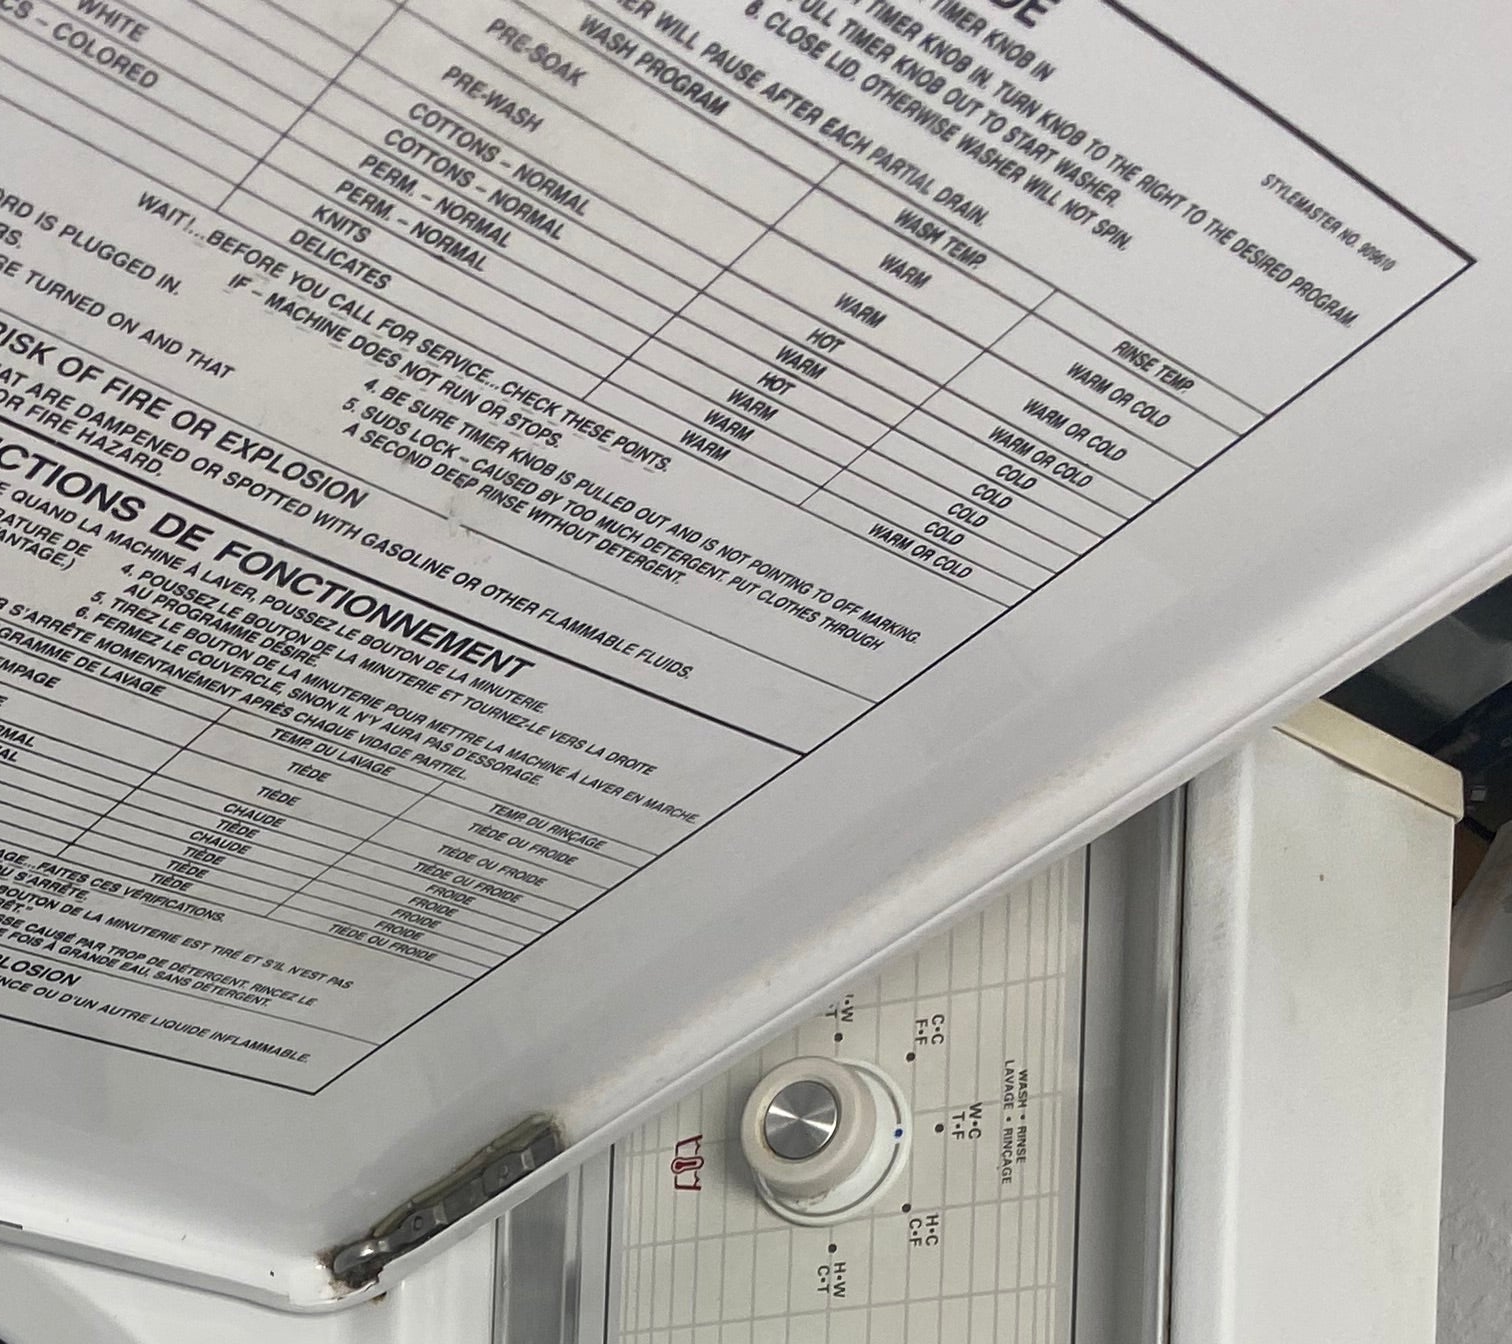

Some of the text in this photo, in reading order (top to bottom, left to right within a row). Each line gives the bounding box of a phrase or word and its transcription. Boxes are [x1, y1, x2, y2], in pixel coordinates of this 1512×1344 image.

[485, 18, 587, 87] PRE-SOAK
[579, 17, 729, 116] WASH PROGRAM
[441, 65, 543, 133] PRE-WASH
[311, 204, 372, 243] KNITS
[893, 209, 947, 244] WASH
[1260, 173, 1342, 234] STYLEMASTER
[1336, 228, 1360, 246] NO.
[288, 228, 392, 290] DELICATES
[878, 253, 932, 289] WARM
[1111, 340, 1159, 372] RINSE
[1066, 362, 1171, 428] WARM OR COLD
[56, 356, 105, 383] OF
[100, 376, 172, 420] FIRE
[170, 410, 217, 441] OR
[214, 430, 369, 509] EXPLOSION
[24, 382, 76, 411] ARE
[73, 402, 190, 463] DAMPENED
[190, 456, 224, 479] OR
[221, 471, 312, 518] SPOTTED
[311, 509, 363, 540] WITH
[360, 532, 455, 579] GASOLINE
[451, 571, 482, 591] OR
[480, 584, 540, 615] OTHER
[536, 607, 640, 655] FLAMMABLE
[633, 648, 694, 679] FLUIDS.
[149, 512, 215, 552] DE
[212, 540, 536, 678] FONCTIONNEMENT
[72, 656, 102, 673] DE
[99, 665, 167, 697] LAVAGE
[311, 742, 339, 757] DU
[336, 750, 396, 777] LAVAGE
[222, 802, 286, 828] CHAUDE
[1004, 1060, 1015, 1110] LAVAGE
[1016, 1069, 1028, 1164] WASH RINSE
